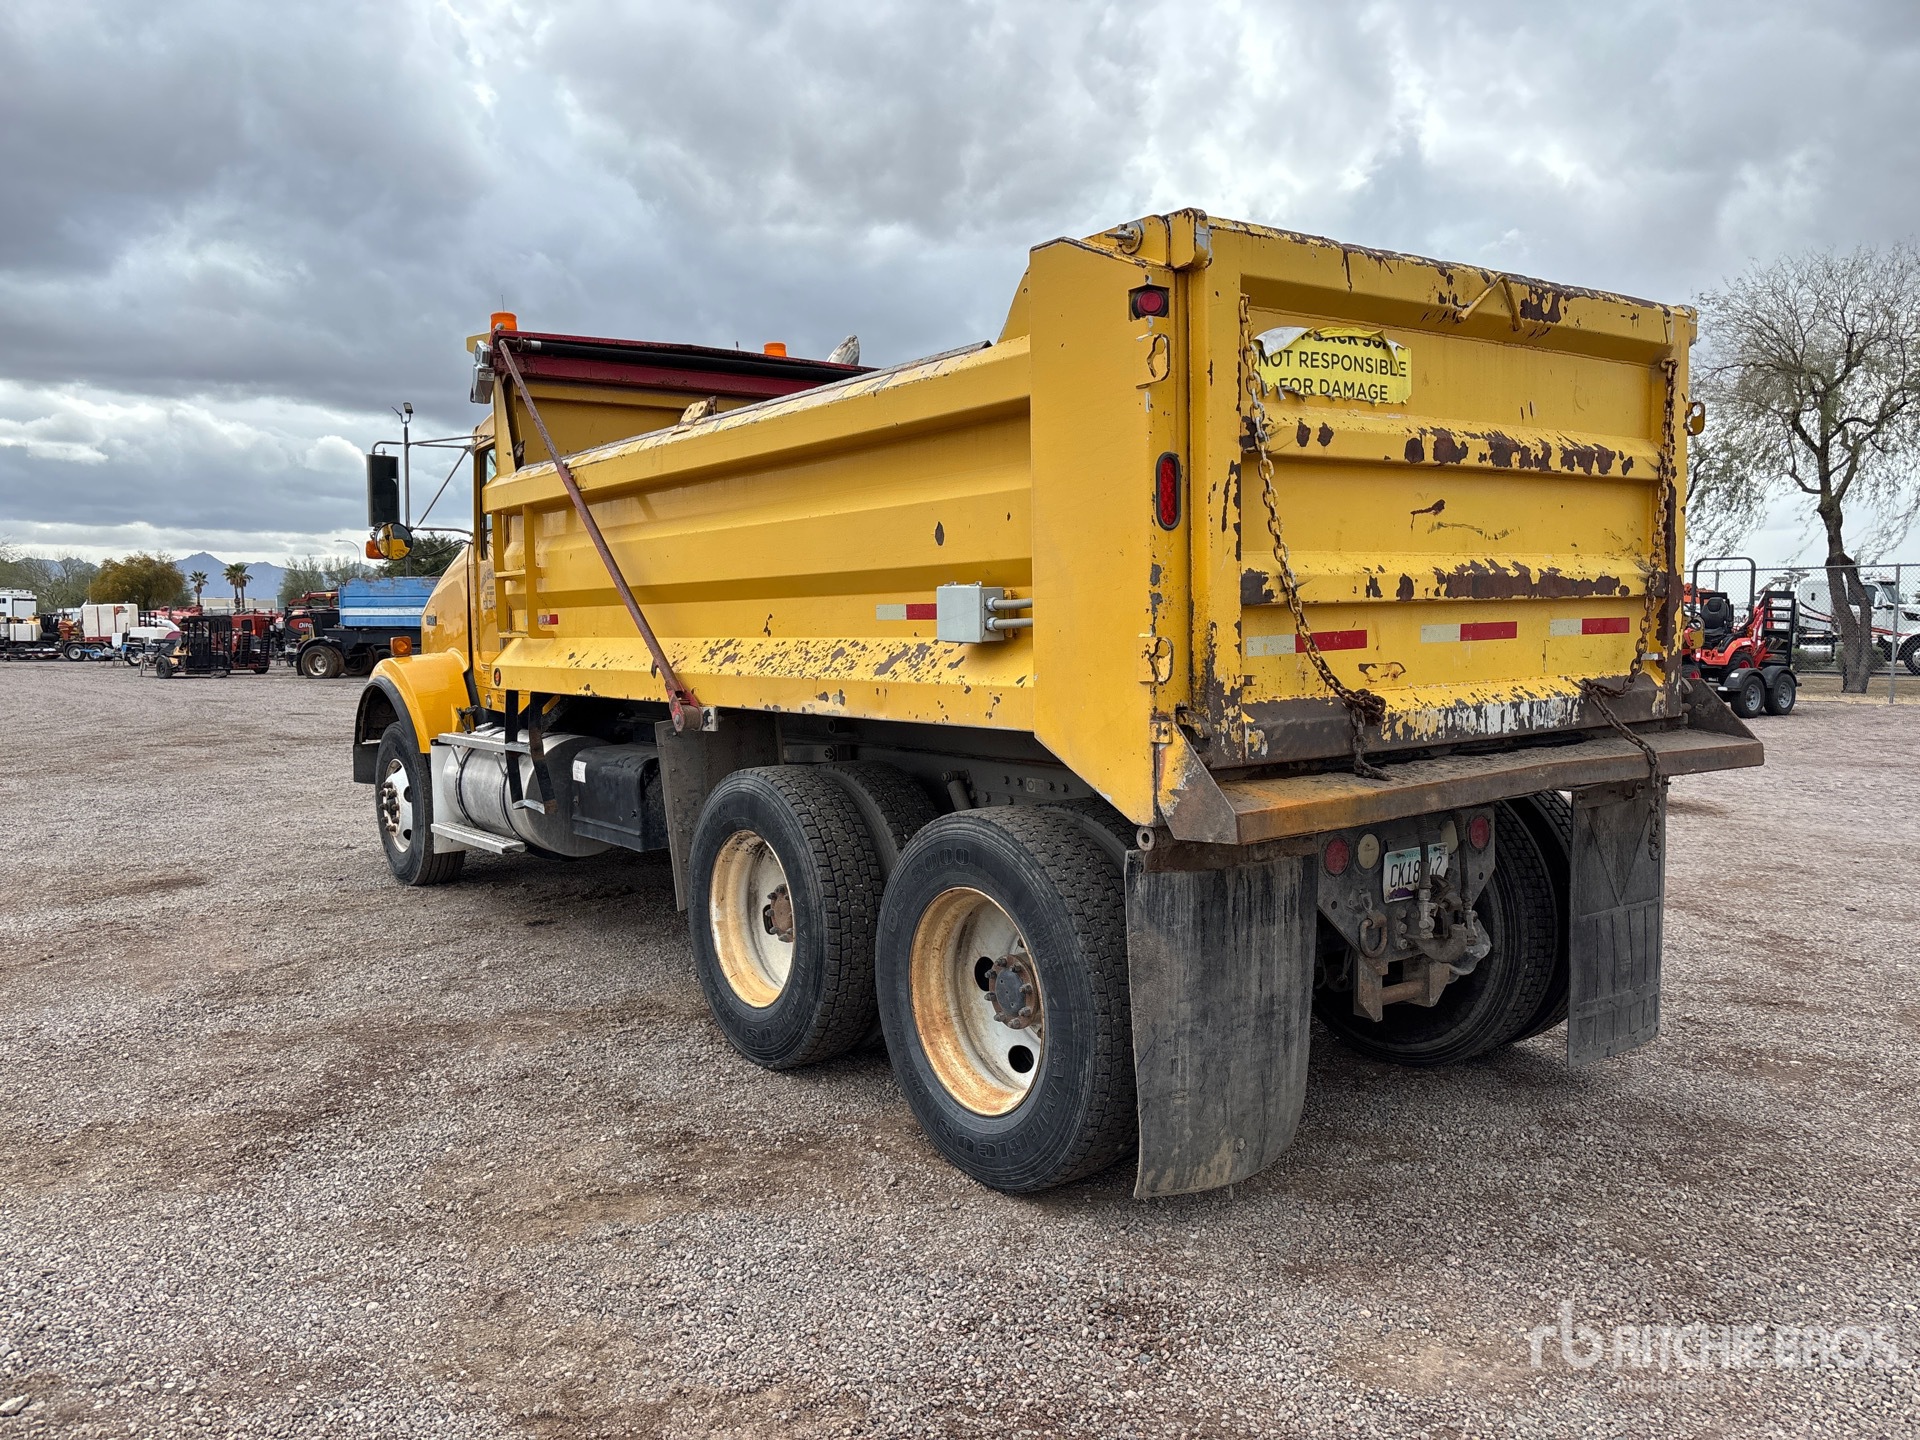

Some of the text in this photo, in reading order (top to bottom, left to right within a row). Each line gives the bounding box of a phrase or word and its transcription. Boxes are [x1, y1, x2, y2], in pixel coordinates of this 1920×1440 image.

[1258, 349, 1407, 378] NOT RESPONSIBLE
[1279, 377, 1388, 401] FOR DAMAGE
